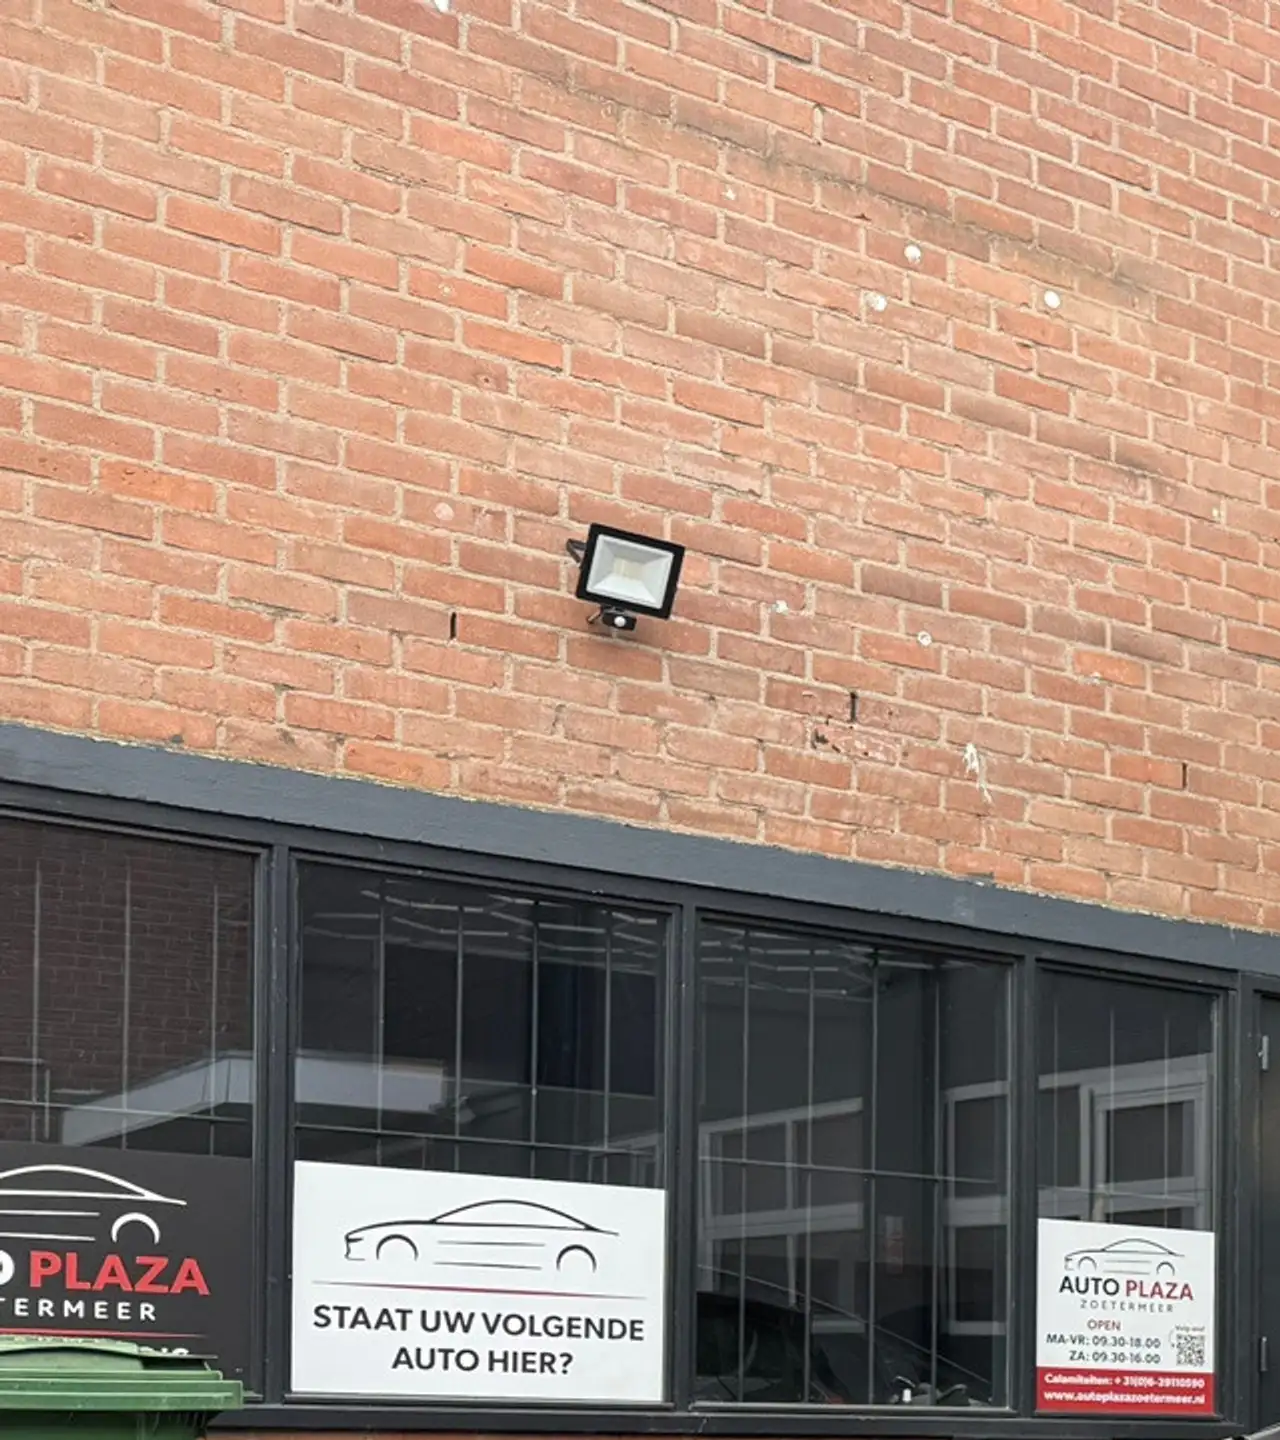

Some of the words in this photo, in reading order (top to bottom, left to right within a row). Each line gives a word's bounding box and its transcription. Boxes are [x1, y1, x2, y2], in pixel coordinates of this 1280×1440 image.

[30, 1250, 211, 1295] PLAZA
[1059, 1276, 1120, 1296] AUTO
[1126, 1280, 1193, 1300] PLAZA
[1080, 1299, 1173, 1312] ZOETERMEER
[313, 1304, 413, 1331] STAAT
[420, 1309, 475, 1333] UW
[482, 1313, 645, 1341] VOLGENDE
[1087, 1319, 1121, 1331] OPEN
[392, 1347, 479, 1372] AUTO
[487, 1350, 573, 1375] HIER?
[1069, 1350, 1090, 1362] ZA:
